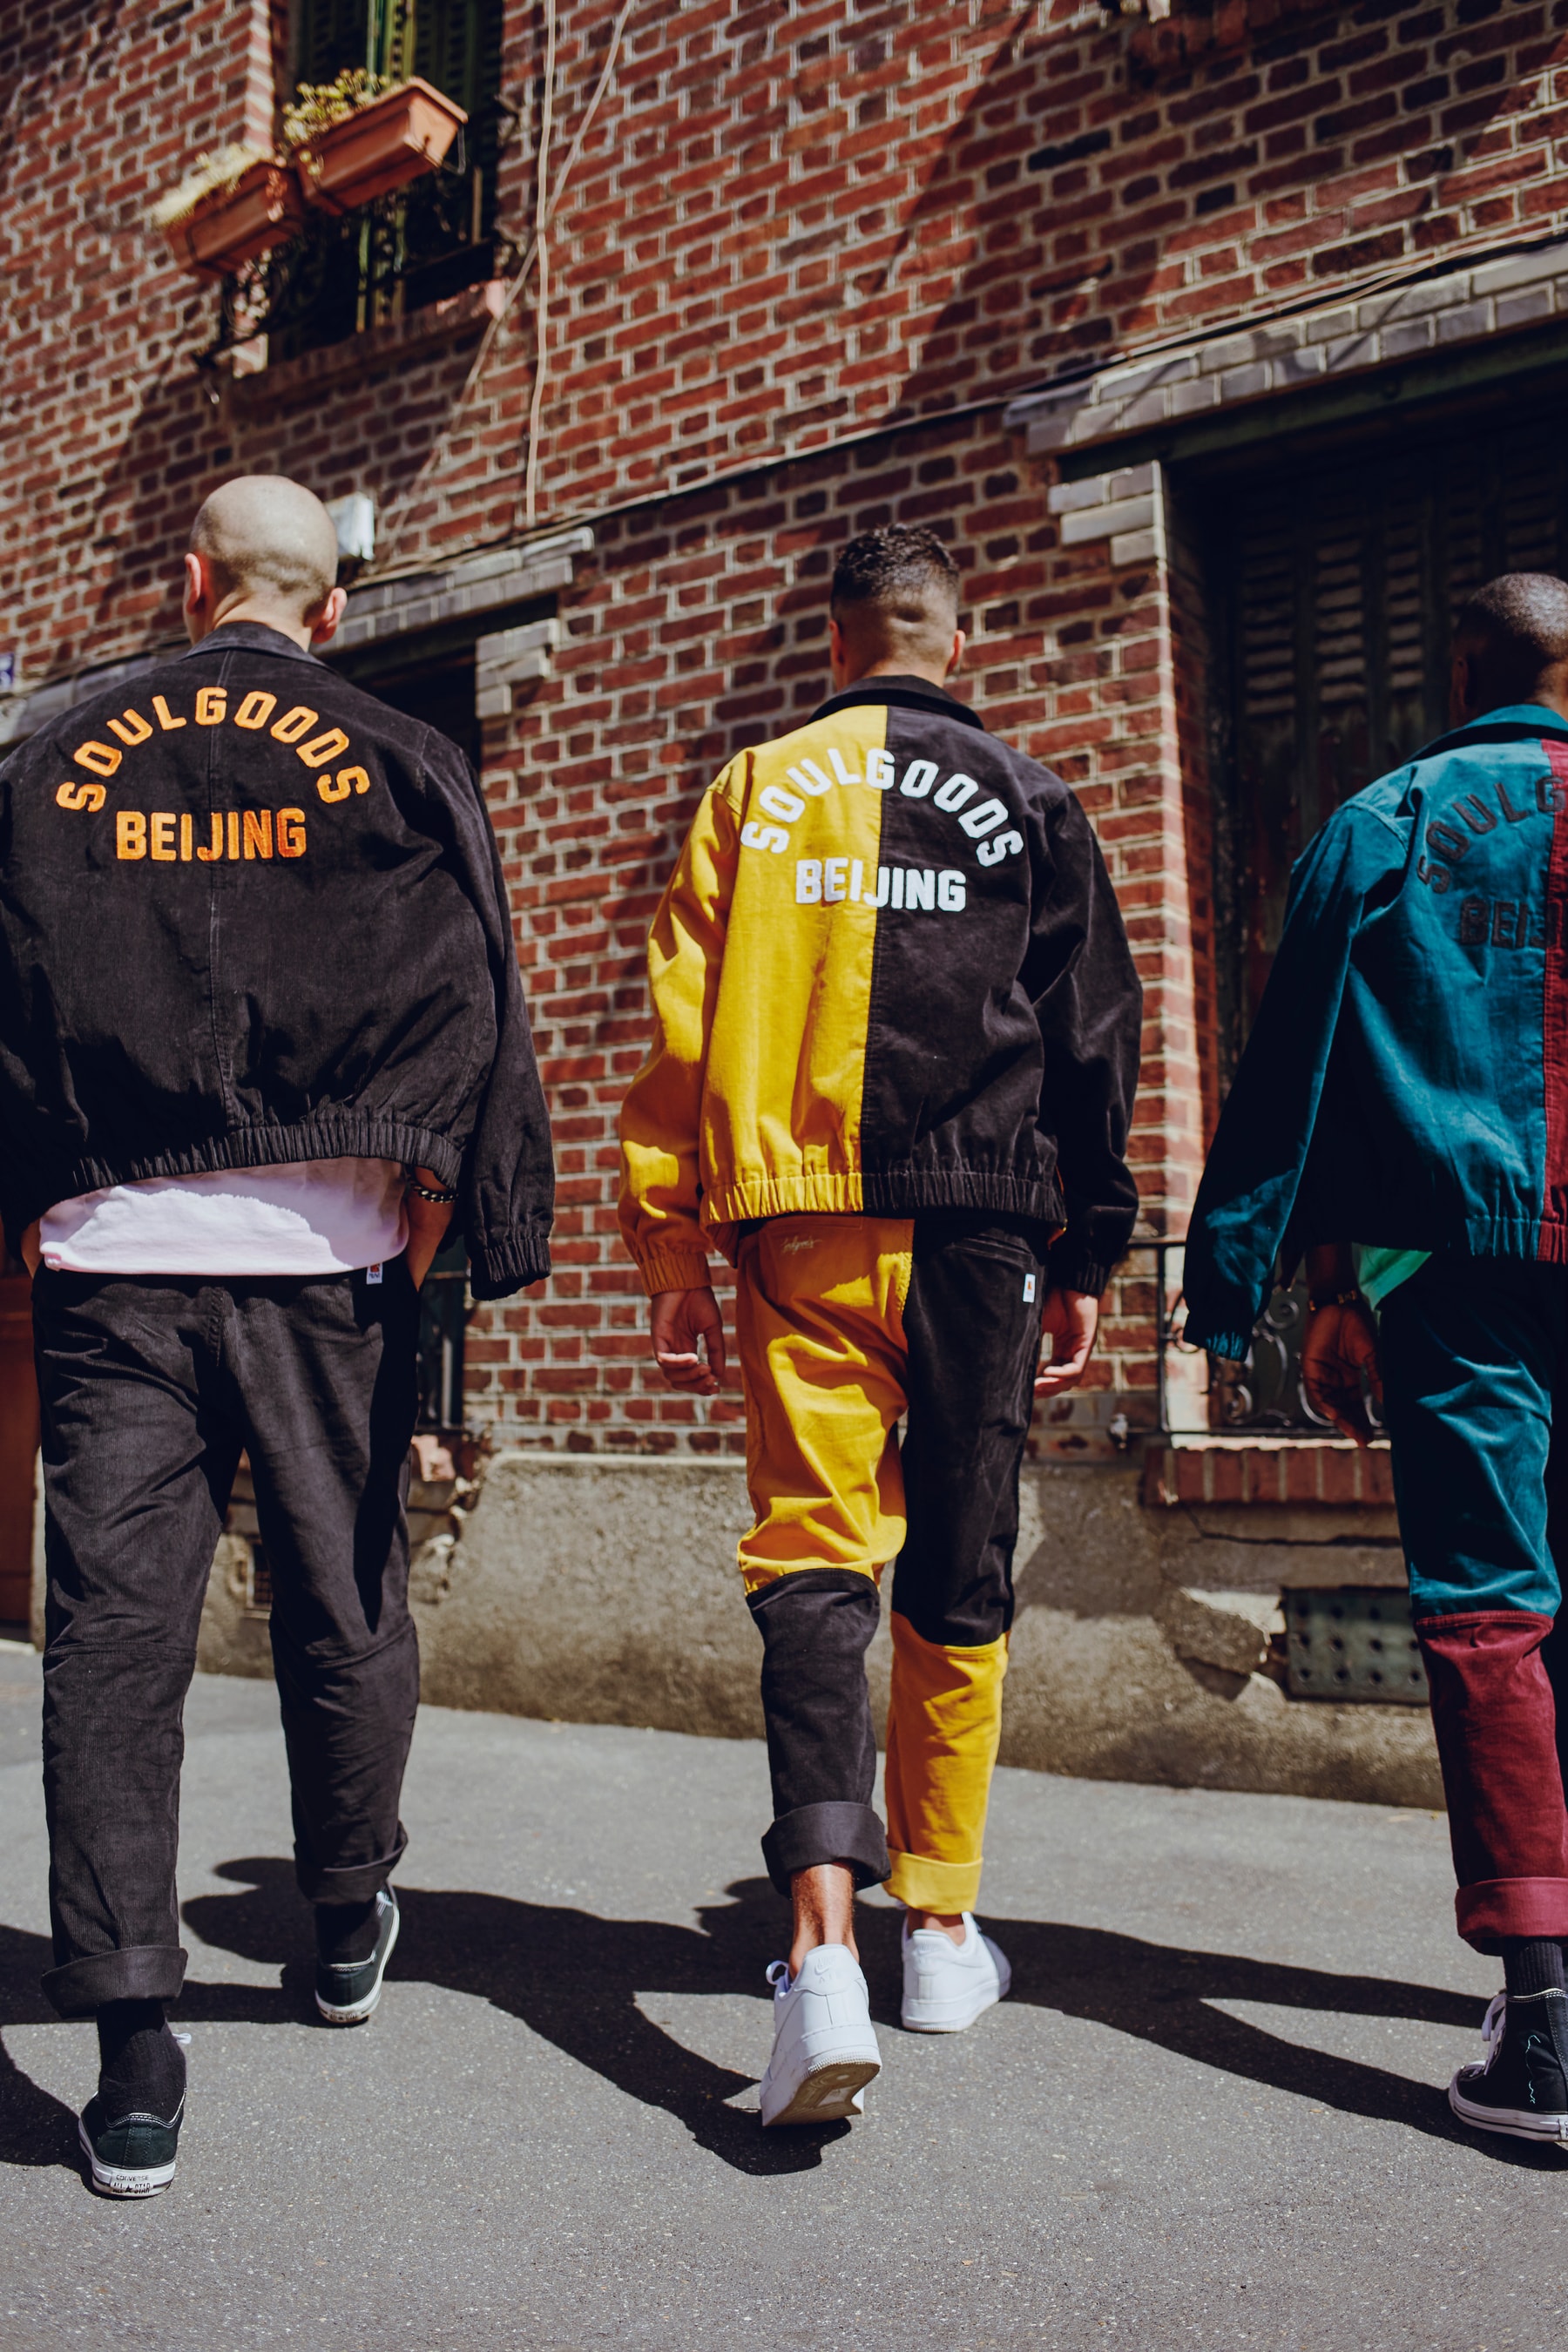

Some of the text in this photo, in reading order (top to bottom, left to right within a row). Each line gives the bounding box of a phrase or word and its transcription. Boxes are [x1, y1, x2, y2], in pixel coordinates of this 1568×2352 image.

[56, 686, 370, 813] SOULGOODS
[116, 808, 307, 862] BEIJING
[740, 747, 1024, 868] SOULGOODS
[795, 857, 967, 912] BEIJING
